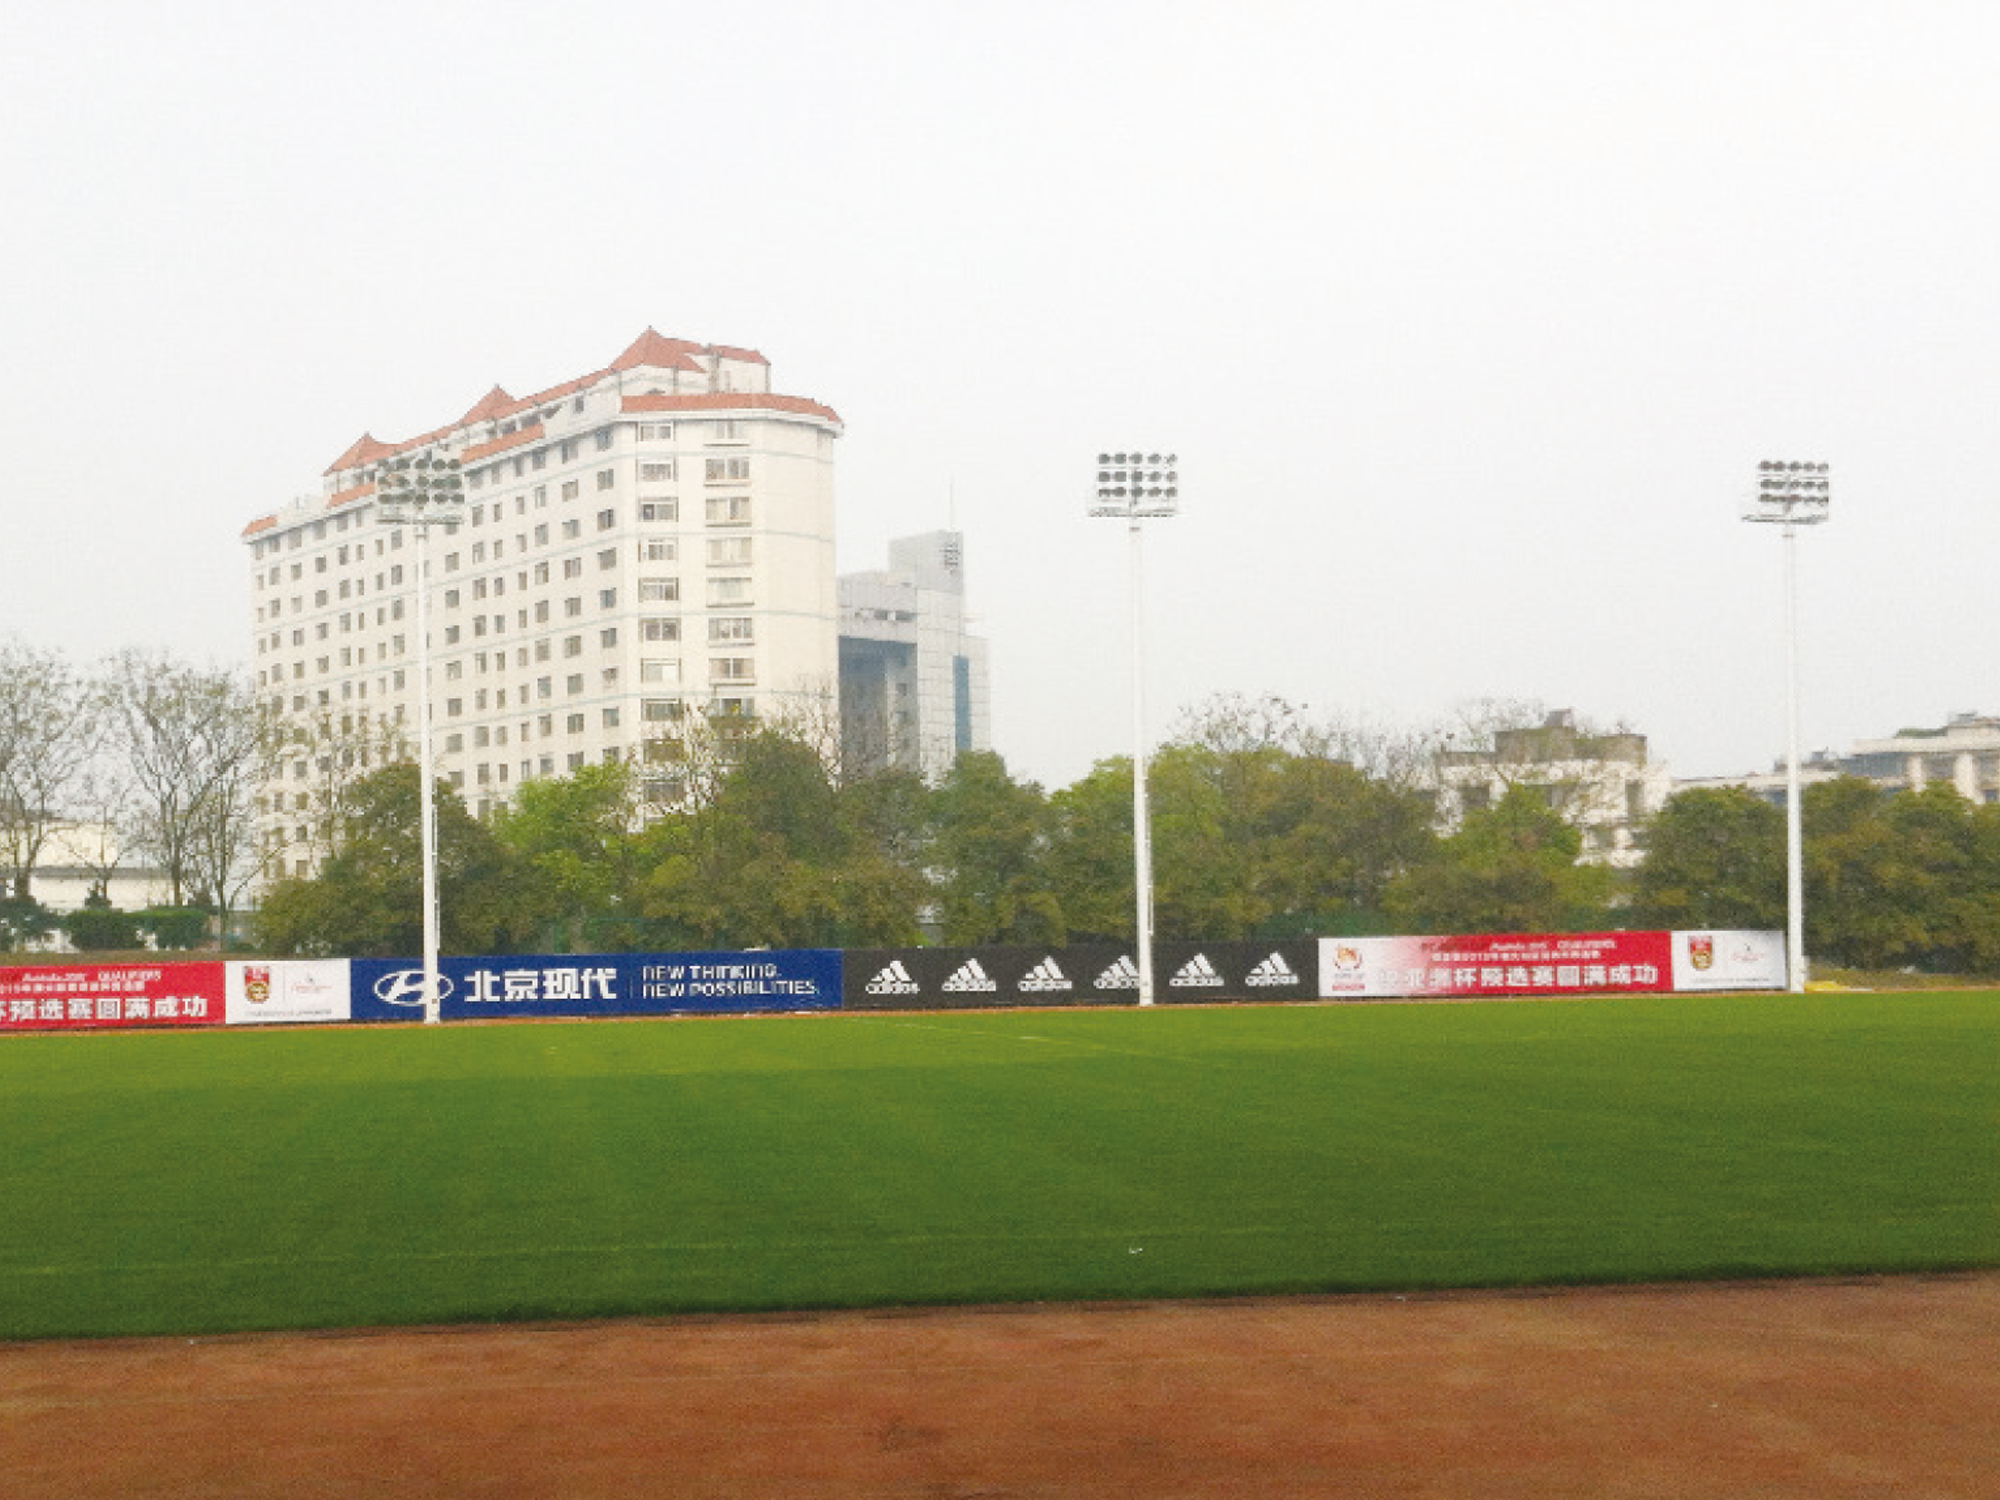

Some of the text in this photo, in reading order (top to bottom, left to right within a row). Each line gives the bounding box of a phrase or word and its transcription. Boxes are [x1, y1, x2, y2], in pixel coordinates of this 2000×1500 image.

[463, 967, 617, 1002] 北京现代
[642, 966, 685, 982] NEW
[1379, 962, 1658, 990] 亚洲杯预选赛圆满成功
[642, 983, 685, 999] NEW
